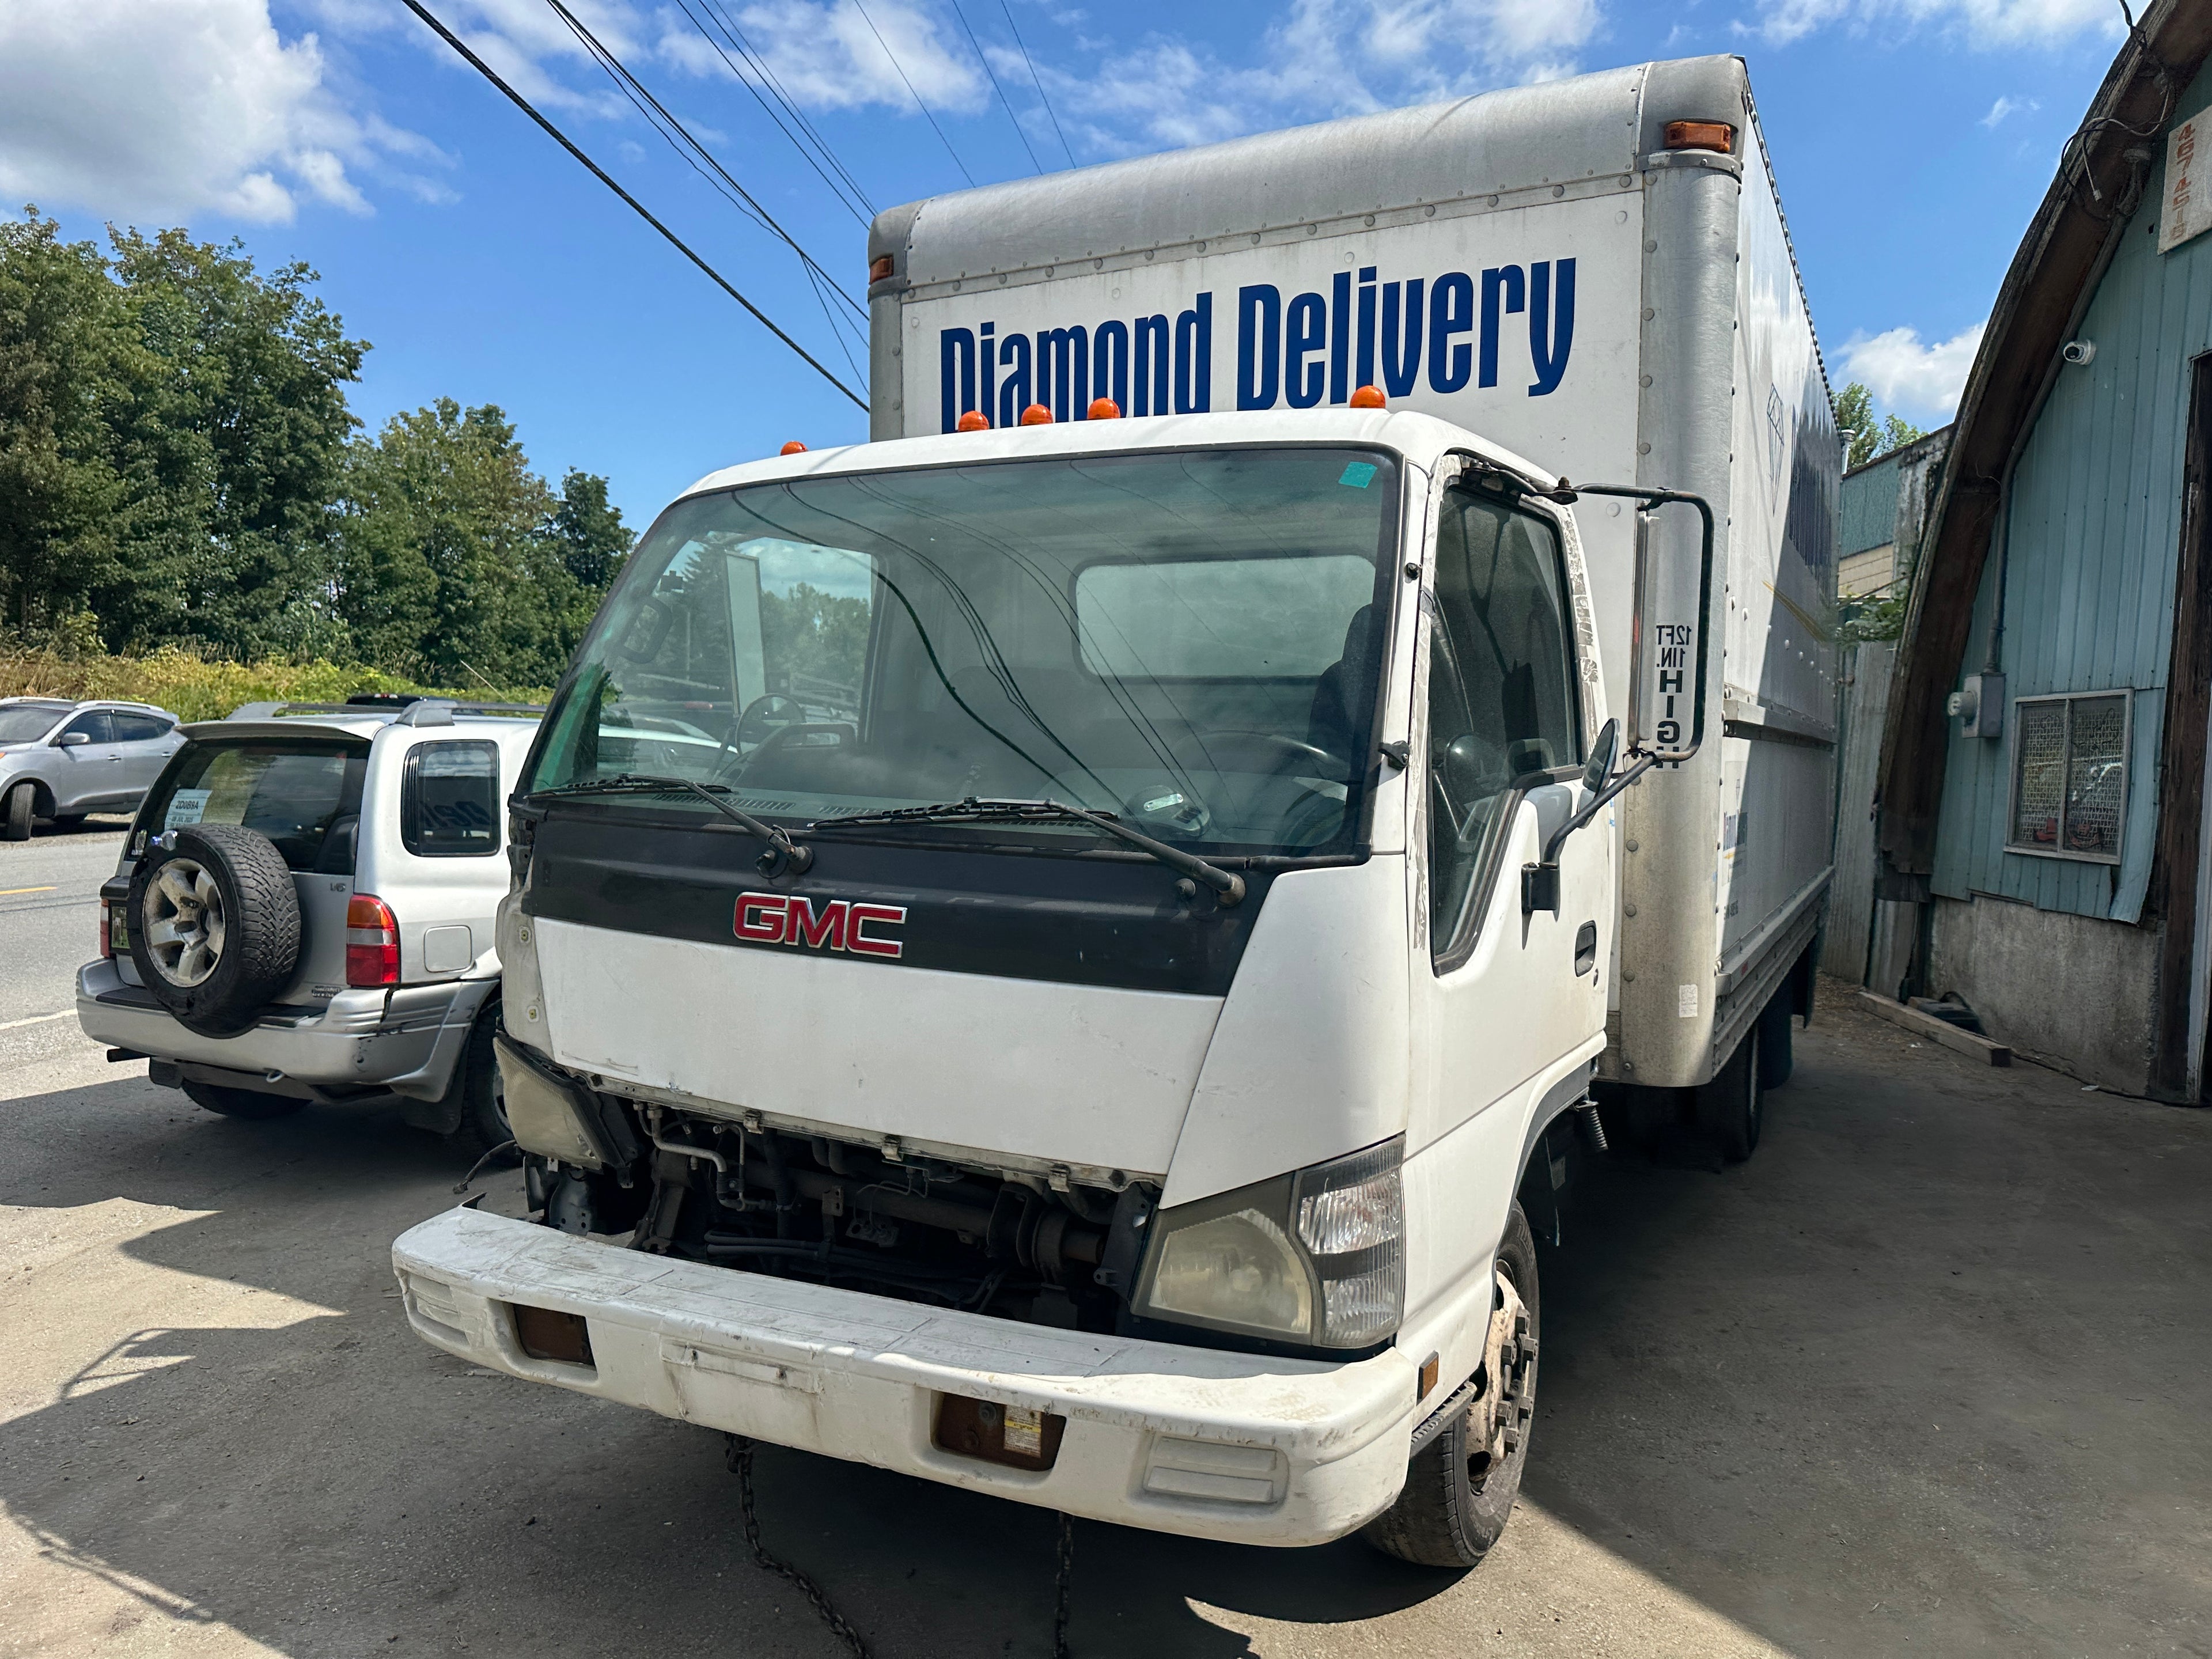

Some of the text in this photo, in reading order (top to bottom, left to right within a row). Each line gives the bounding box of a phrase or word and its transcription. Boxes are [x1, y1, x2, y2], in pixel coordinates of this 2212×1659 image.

[941, 257, 1576, 434] Diamond Delivery
[733, 891, 908, 958] GMC
